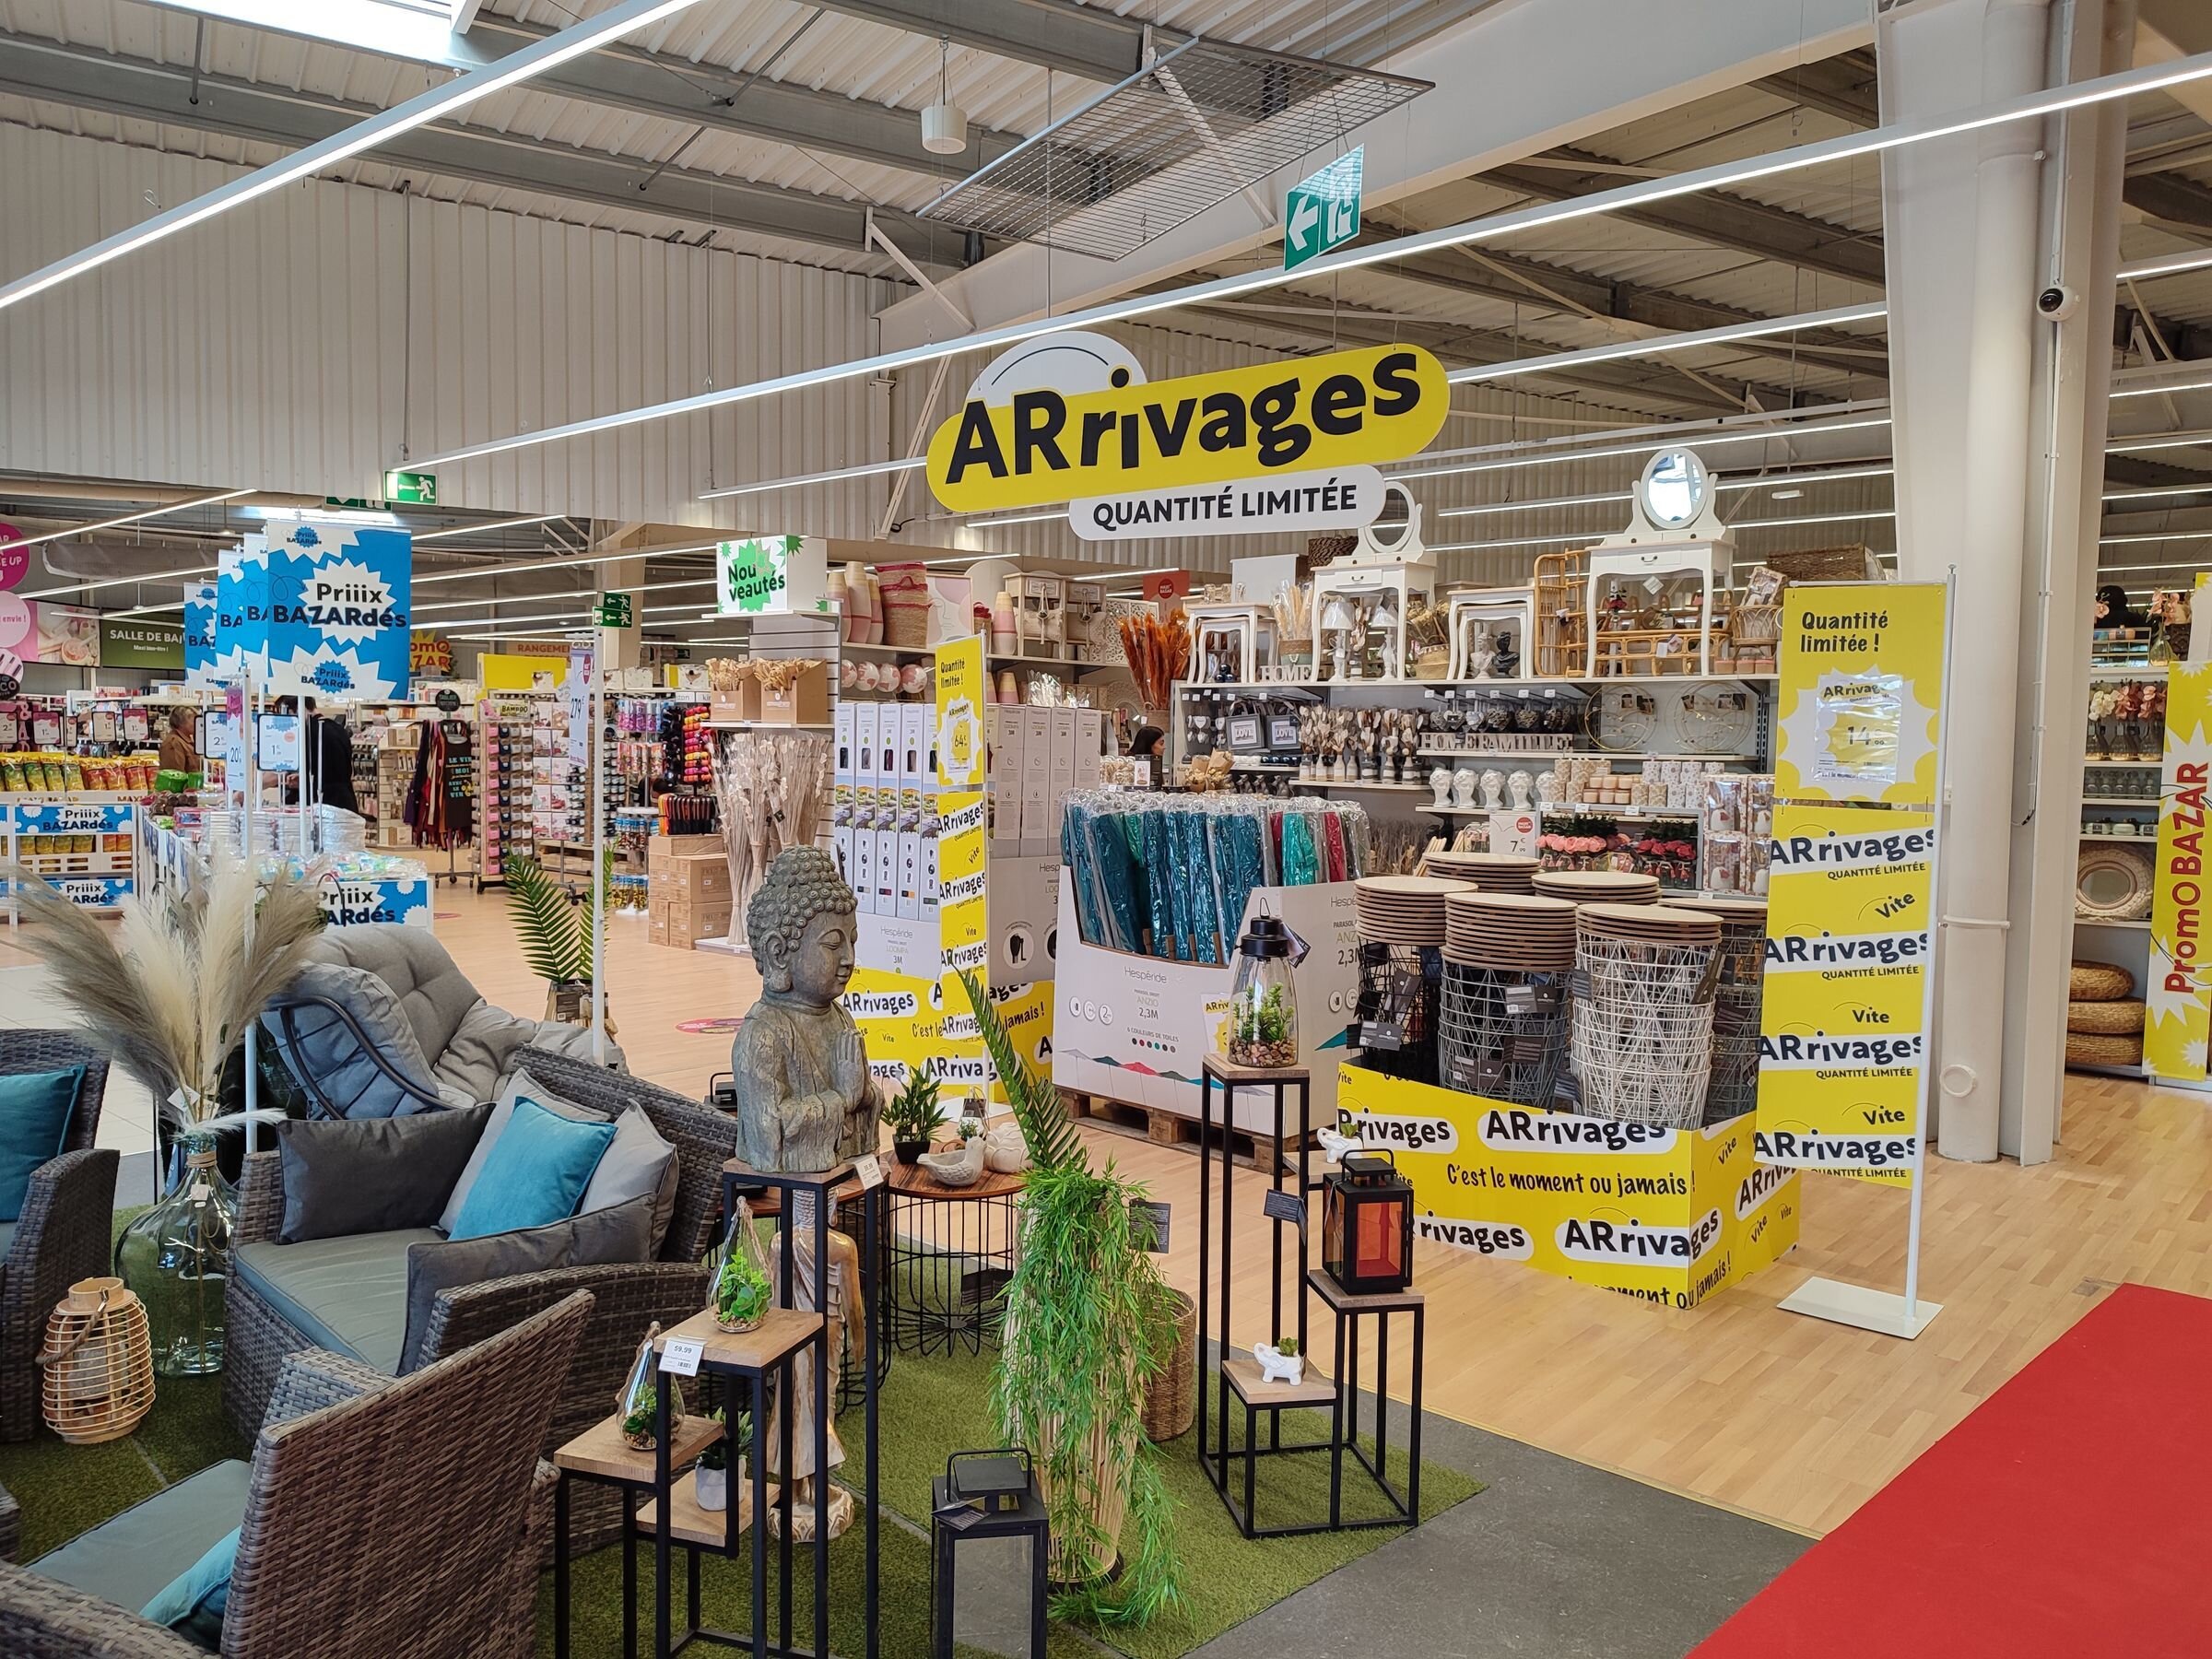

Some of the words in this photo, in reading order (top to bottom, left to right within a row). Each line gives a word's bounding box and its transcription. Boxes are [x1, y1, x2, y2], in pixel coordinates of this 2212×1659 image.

[945, 352, 1421, 485] ARrivages
[1093, 487, 1233, 531] QUANTITÉ
[1241, 477, 1358, 514] LIMITÉE
[9, 557, 22, 566] UP
[727, 563, 756, 584] Nou
[317, 582, 383, 604] Priiix
[729, 571, 785, 602] veautés
[273, 605, 407, 628] BAZARdés
[1802, 610, 1888, 630] Quantité
[110, 629, 145, 641] SALLE
[147, 631, 162, 642] DE
[1800, 634, 1868, 653] limitée
[1874, 633, 1879, 652] !
[410, 655, 450, 668] ZAR
[941, 657, 966, 674] Quantité
[319, 668, 347, 679] Priiix
[1259, 664, 1312, 682] HOME
[300, 676, 355, 689] BAZARdés
[941, 676, 960, 688] limitée
[65, 809, 100, 818] Priiix
[938, 802, 983, 833] ARrivages
[42, 819, 113, 830] BAZARdés
[1771, 829, 1934, 865] ARrivages
[1827, 865, 1881, 880] QUANTITÉ
[1884, 861, 1926, 874] LIMITÉE
[66, 883, 101, 893] Priiix
[940, 872, 985, 900] ARrivages
[1874, 893, 1915, 919] Vite
[880, 925, 913, 938] Hespéride
[966, 924, 977, 936] Vite
[1333, 920, 1355, 928] PARASOL
[1764, 932, 1927, 964] ARrivages
[893, 955, 902, 965] 3M
[1124, 966, 1167, 983] Hespéride
[1821, 967, 1875, 981] QUANTITÉ
[1877, 964, 1919, 976] LIMITÉE
[843, 989, 914, 1015] ARrivages
[1004, 1006, 1040, 1033] jamais
[1138, 1007, 1159, 1019] 2,3M
[1852, 1006, 1889, 1023] Vite
[882, 1033, 895, 1043] Vite
[1131, 1028, 1155, 1038] COULEURS
[1759, 1030, 1922, 1065] ARrivages
[1816, 1067, 1869, 1079] QUANTITÉ
[1871, 1066, 1912, 1077] LIMITÉE
[1863, 1105, 1905, 1125] Vite
[1487, 1110, 1666, 1151] ARrivages
[1717, 1136, 1737, 1165] Vite
[1755, 1129, 1916, 1166] ARrivages
[1447, 1163, 1486, 1187] C'est
[1490, 1166, 1506, 1188] le
[1510, 1172, 1584, 1193] moment
[1590, 1177, 1612, 1194] ou
[1617, 1172, 1688, 1198] jamais
[1865, 1166, 1907, 1178] LIMITÉE
[1781, 1205, 1792, 1220] Vite
[1751, 1215, 1768, 1244] Vite
[674, 1345, 692, 1354] 59.99
